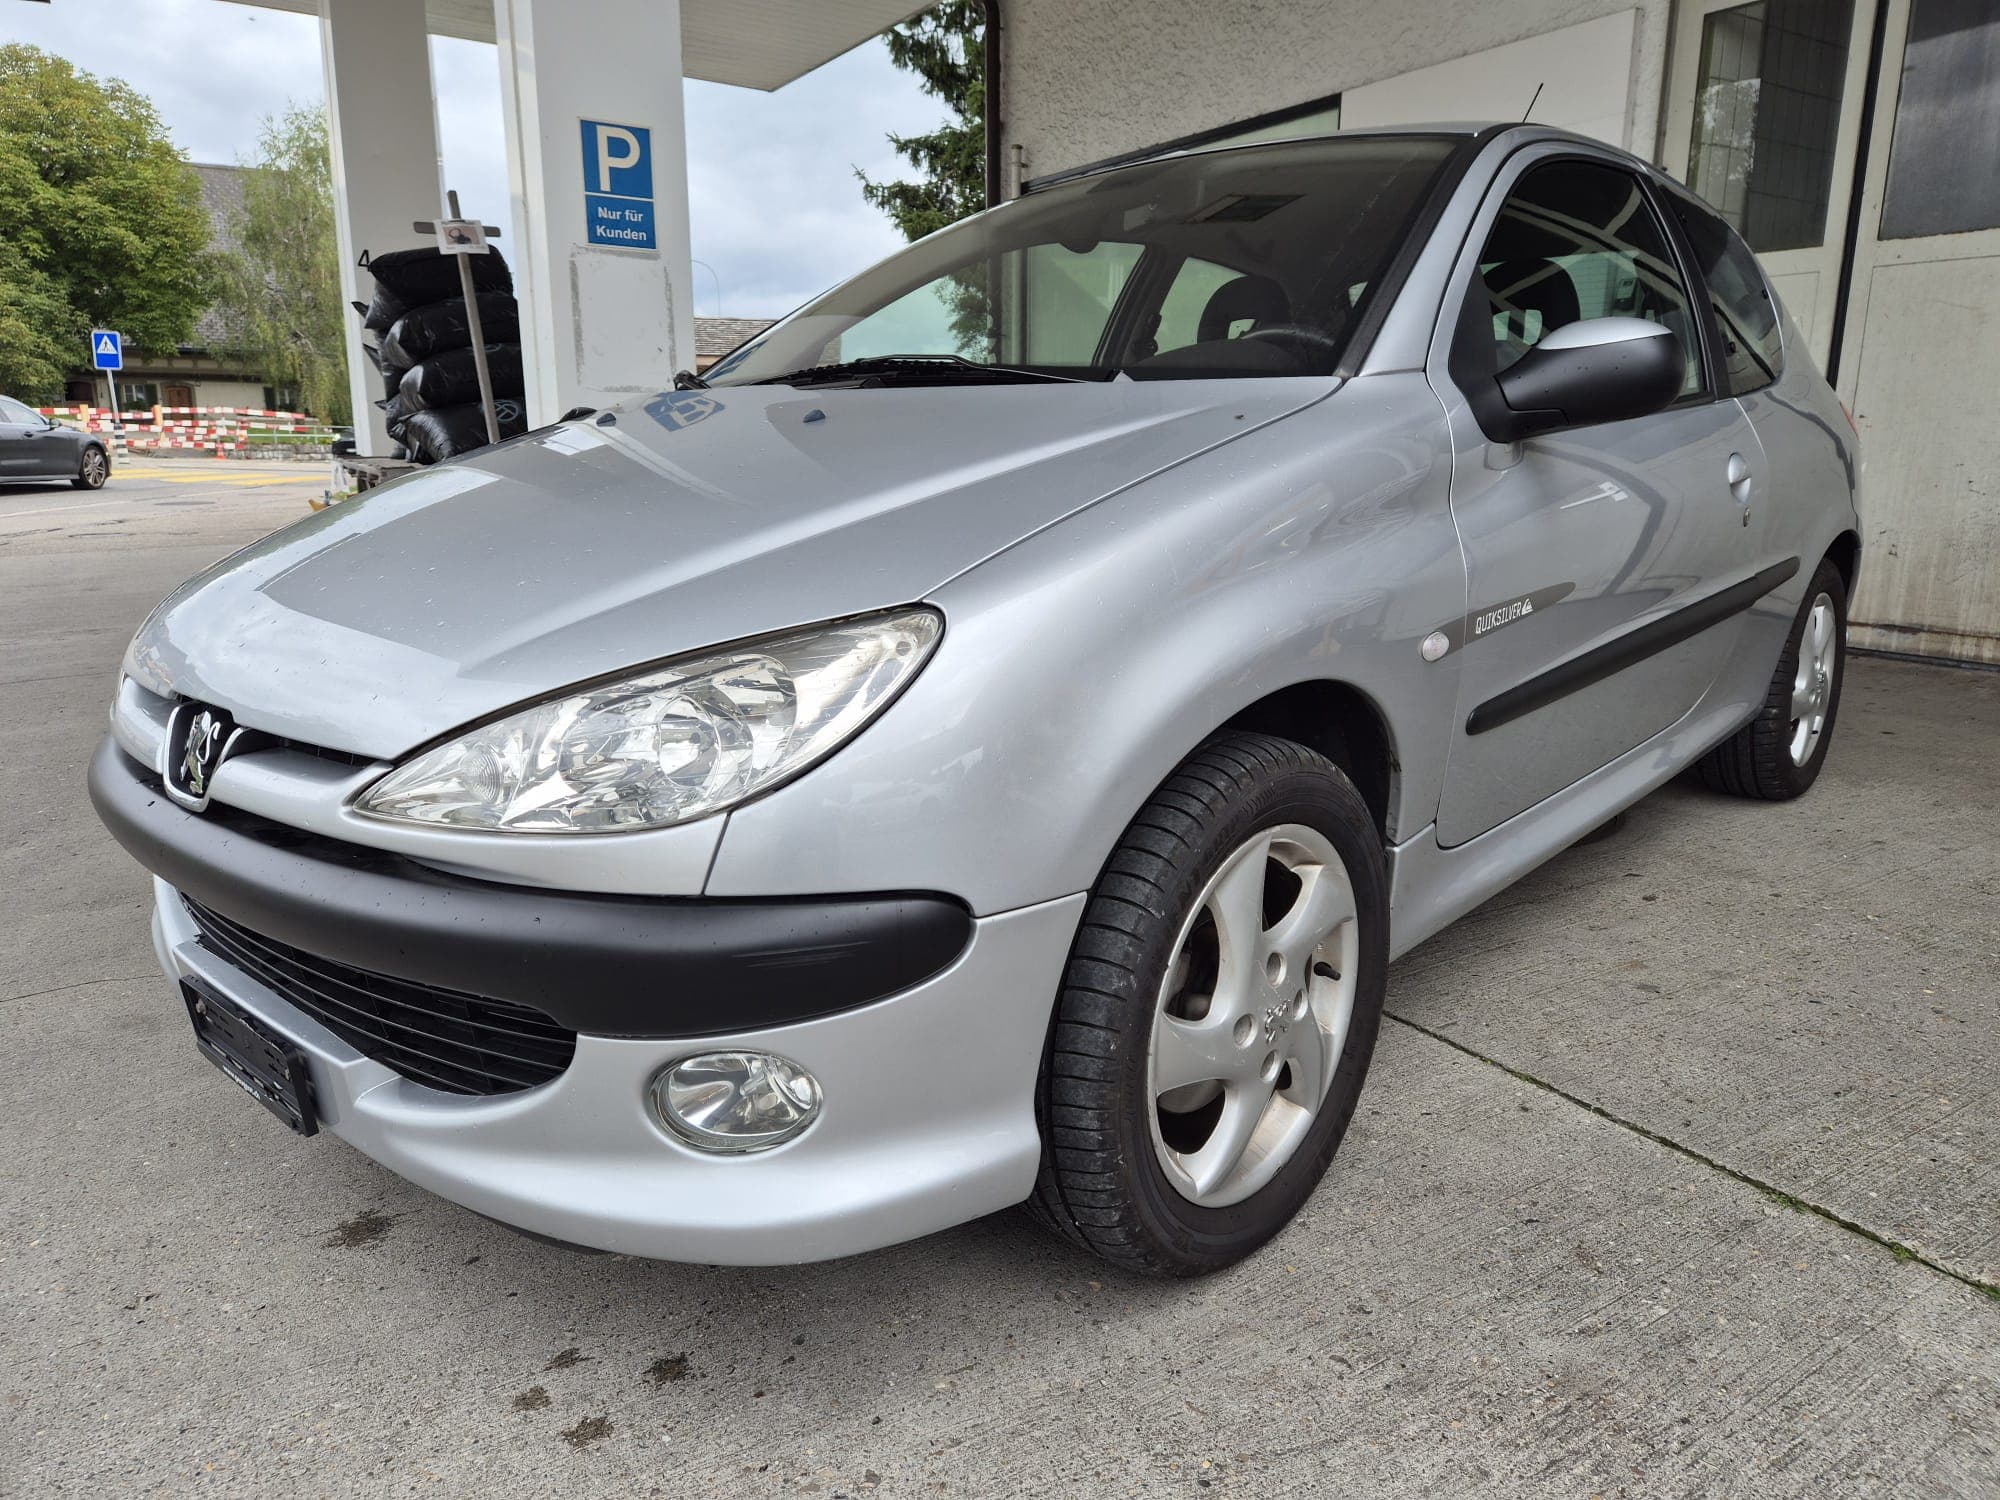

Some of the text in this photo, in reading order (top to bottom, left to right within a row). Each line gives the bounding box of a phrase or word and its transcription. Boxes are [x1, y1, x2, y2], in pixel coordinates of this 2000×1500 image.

[596, 124, 641, 192] P
[597, 206, 644, 223] Nur für
[596, 225, 647, 241] Kunden
[1475, 601, 1522, 634] QUIKSILVER
